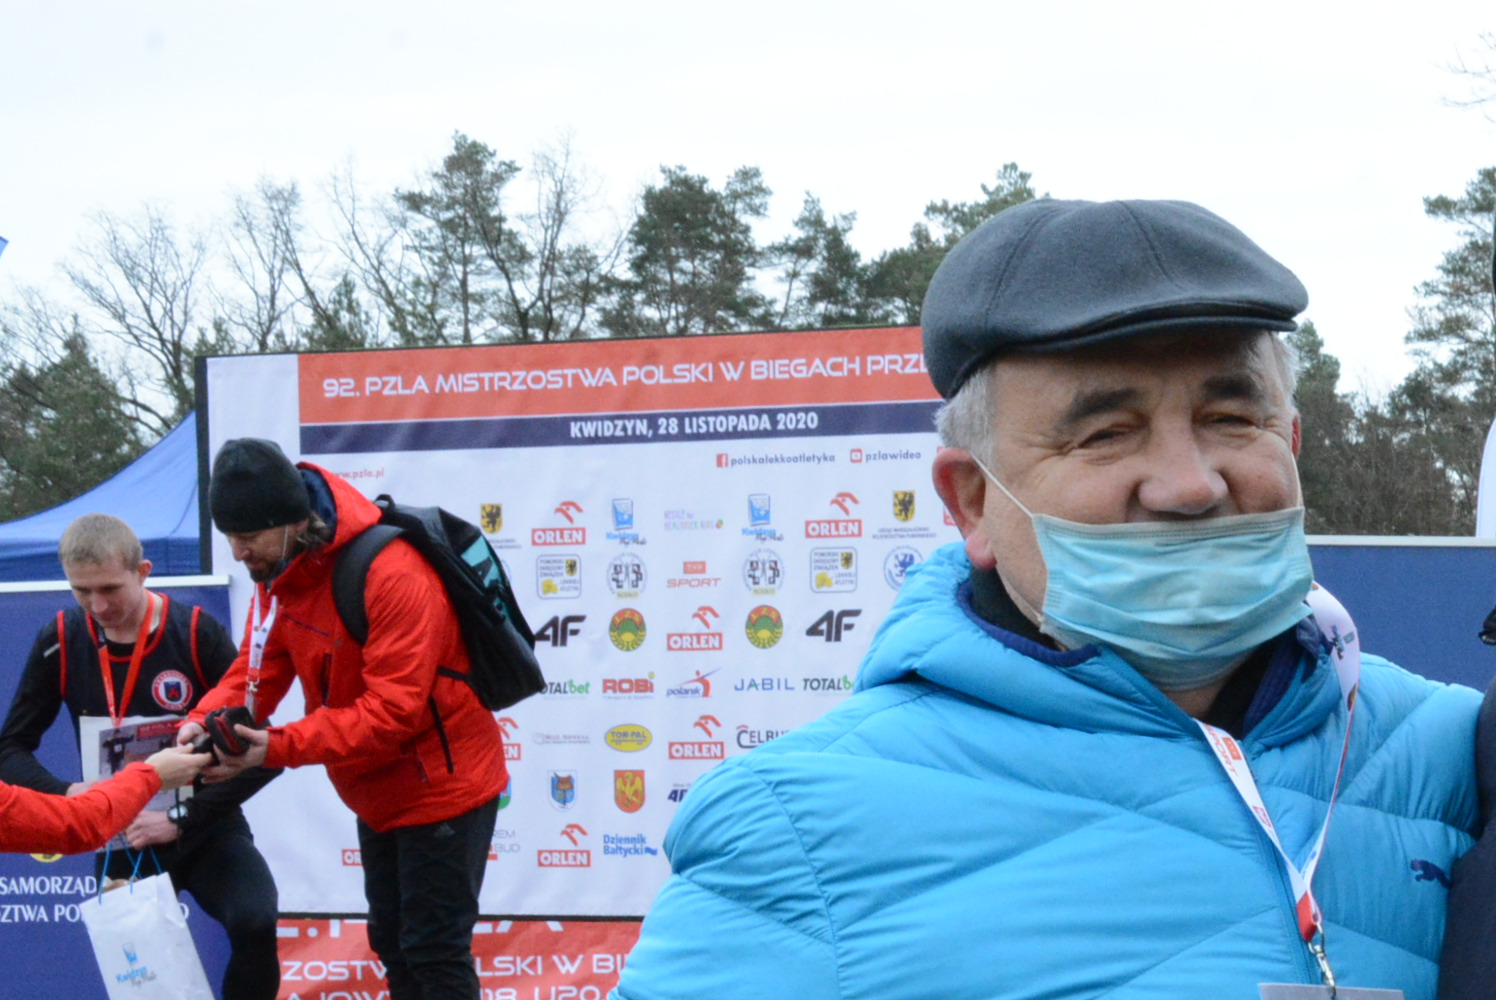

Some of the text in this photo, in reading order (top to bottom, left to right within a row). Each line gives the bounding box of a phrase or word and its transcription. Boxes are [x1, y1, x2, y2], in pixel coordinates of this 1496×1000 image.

[322, 377, 361, 398] 92.
[365, 374, 430, 396] PZLA
[435, 366, 618, 394] MISTRZOSTWA
[622, 362, 714, 386] POLSKI
[719, 360, 745, 382] W
[751, 355, 861, 380] BIEGACH
[570, 411, 819, 439] KWIDZYN, 28 LISTOPADA 2020
[730, 452, 835, 467] polskalekkoatletyka
[865, 450, 922, 463] pzlawideo
[807, 520, 860, 537] ORLEN
[533, 529, 584, 544] ORLEN
[667, 577, 722, 588] SPORT
[534, 614, 587, 647] 4F
[805, 609, 862, 642] 4F
[669, 635, 721, 649] ORLEN
[542, 679, 591, 695] OTALbet
[734, 677, 795, 691] JABIL
[802, 674, 855, 691] TOTALb
[665, 684, 701, 698] polanik
[611, 730, 648, 740] TOR-PAL
[671, 743, 722, 758] ORLEN
[603, 833, 646, 845] Dziennik
[540, 851, 588, 866] ORLEN
[603, 845, 645, 858] Bałtycki
[0, 876, 97, 898] SAMORZĄD
[0, 904, 48, 923] ZTWA
[552, 954, 585, 976] W
